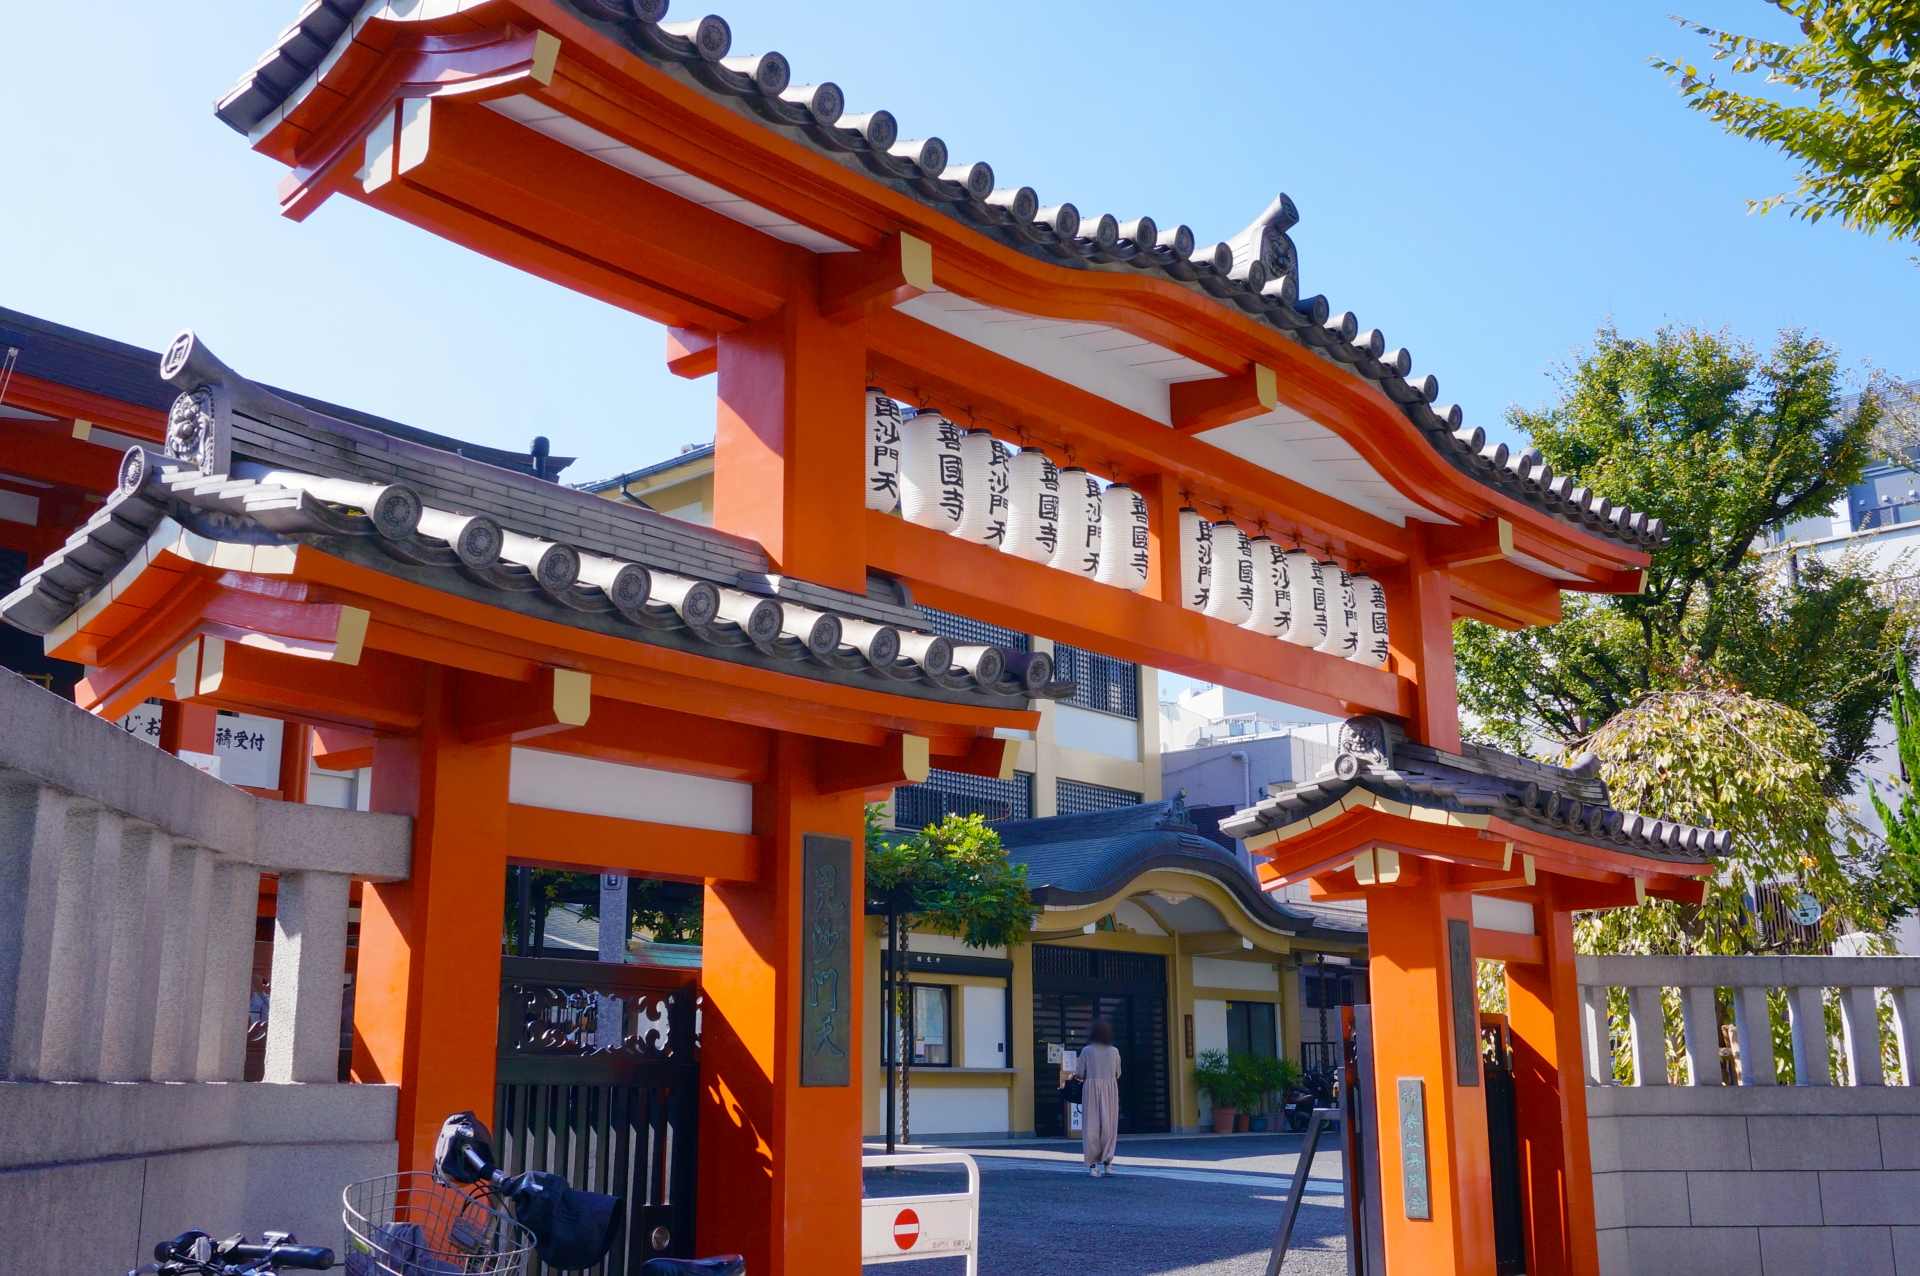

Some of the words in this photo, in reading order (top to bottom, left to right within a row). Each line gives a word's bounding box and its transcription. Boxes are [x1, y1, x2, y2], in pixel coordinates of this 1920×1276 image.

[871, 396, 901, 499] 毘沙門天
[810, 864, 845, 1059] 毘沙門天
